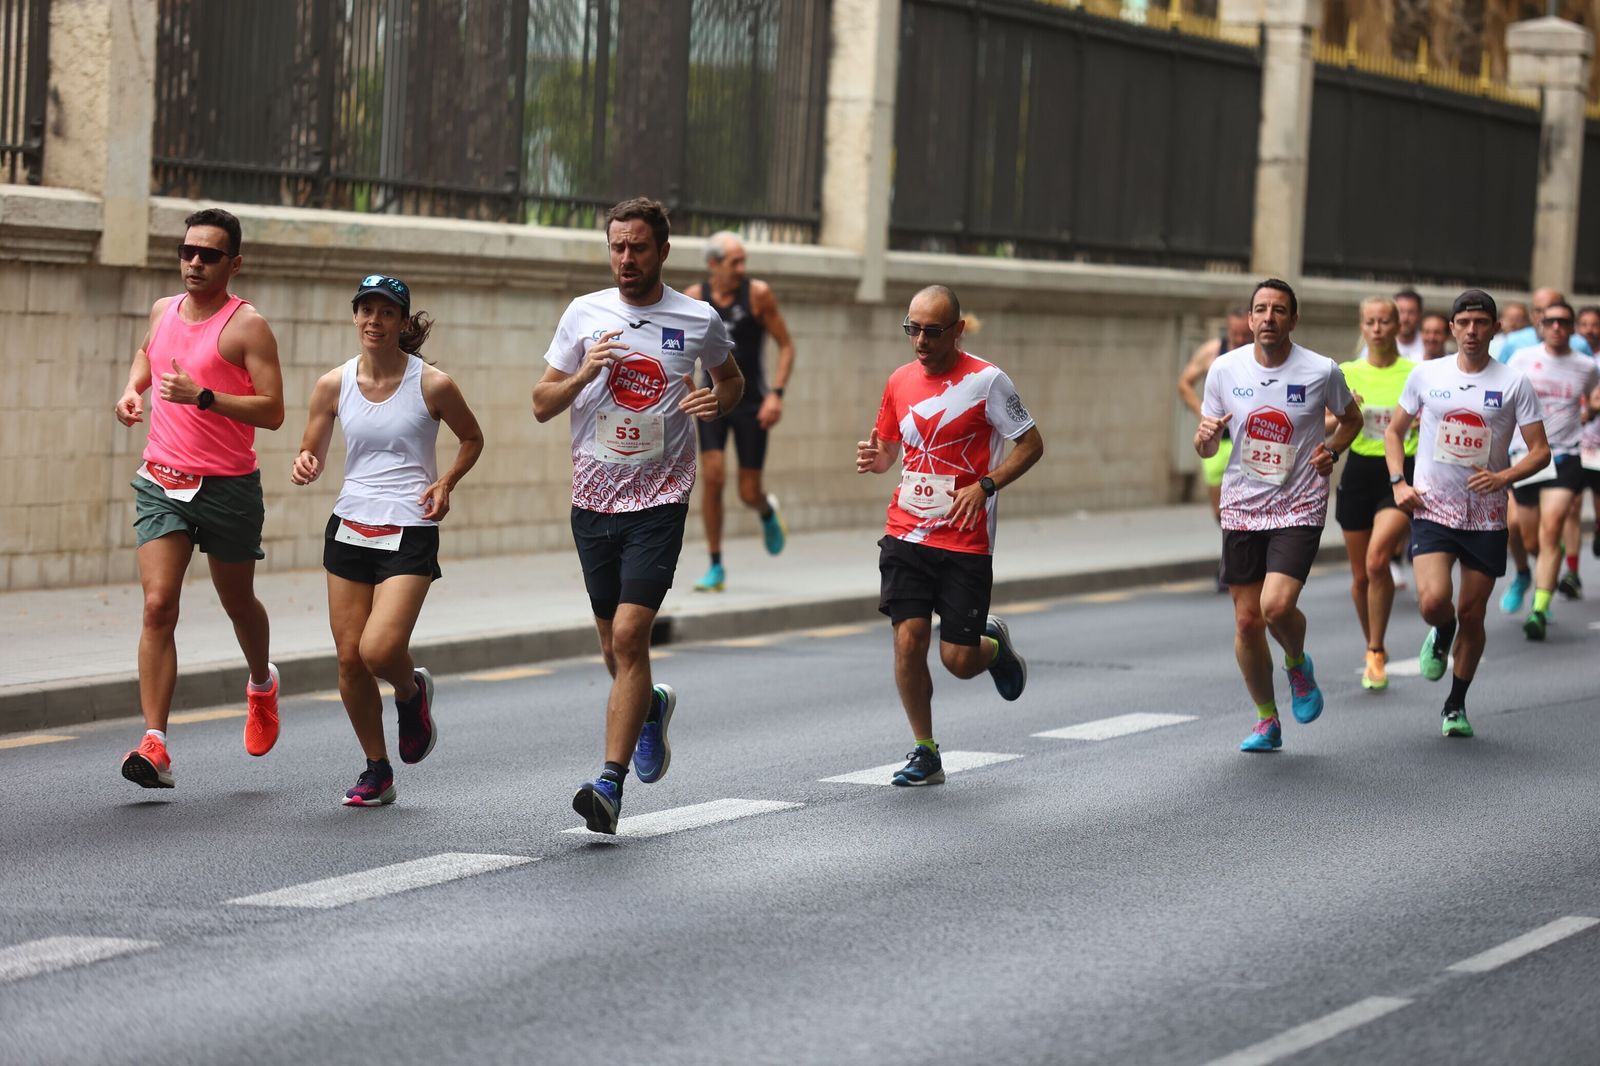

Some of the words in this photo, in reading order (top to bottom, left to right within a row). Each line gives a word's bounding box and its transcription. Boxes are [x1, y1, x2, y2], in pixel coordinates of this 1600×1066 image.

[661, 338, 681, 349] AXA
[619, 366, 660, 389] PONLE
[615, 377, 656, 398] FRENO
[1287, 393, 1303, 402] AXA
[616, 426, 641, 441] 53
[1251, 426, 1285, 442] FRENO
[1253, 417, 1288, 436] PONLE
[1444, 433, 1483, 449] 1186
[1251, 450, 1282, 465] 223
[914, 484, 934, 497] 90
